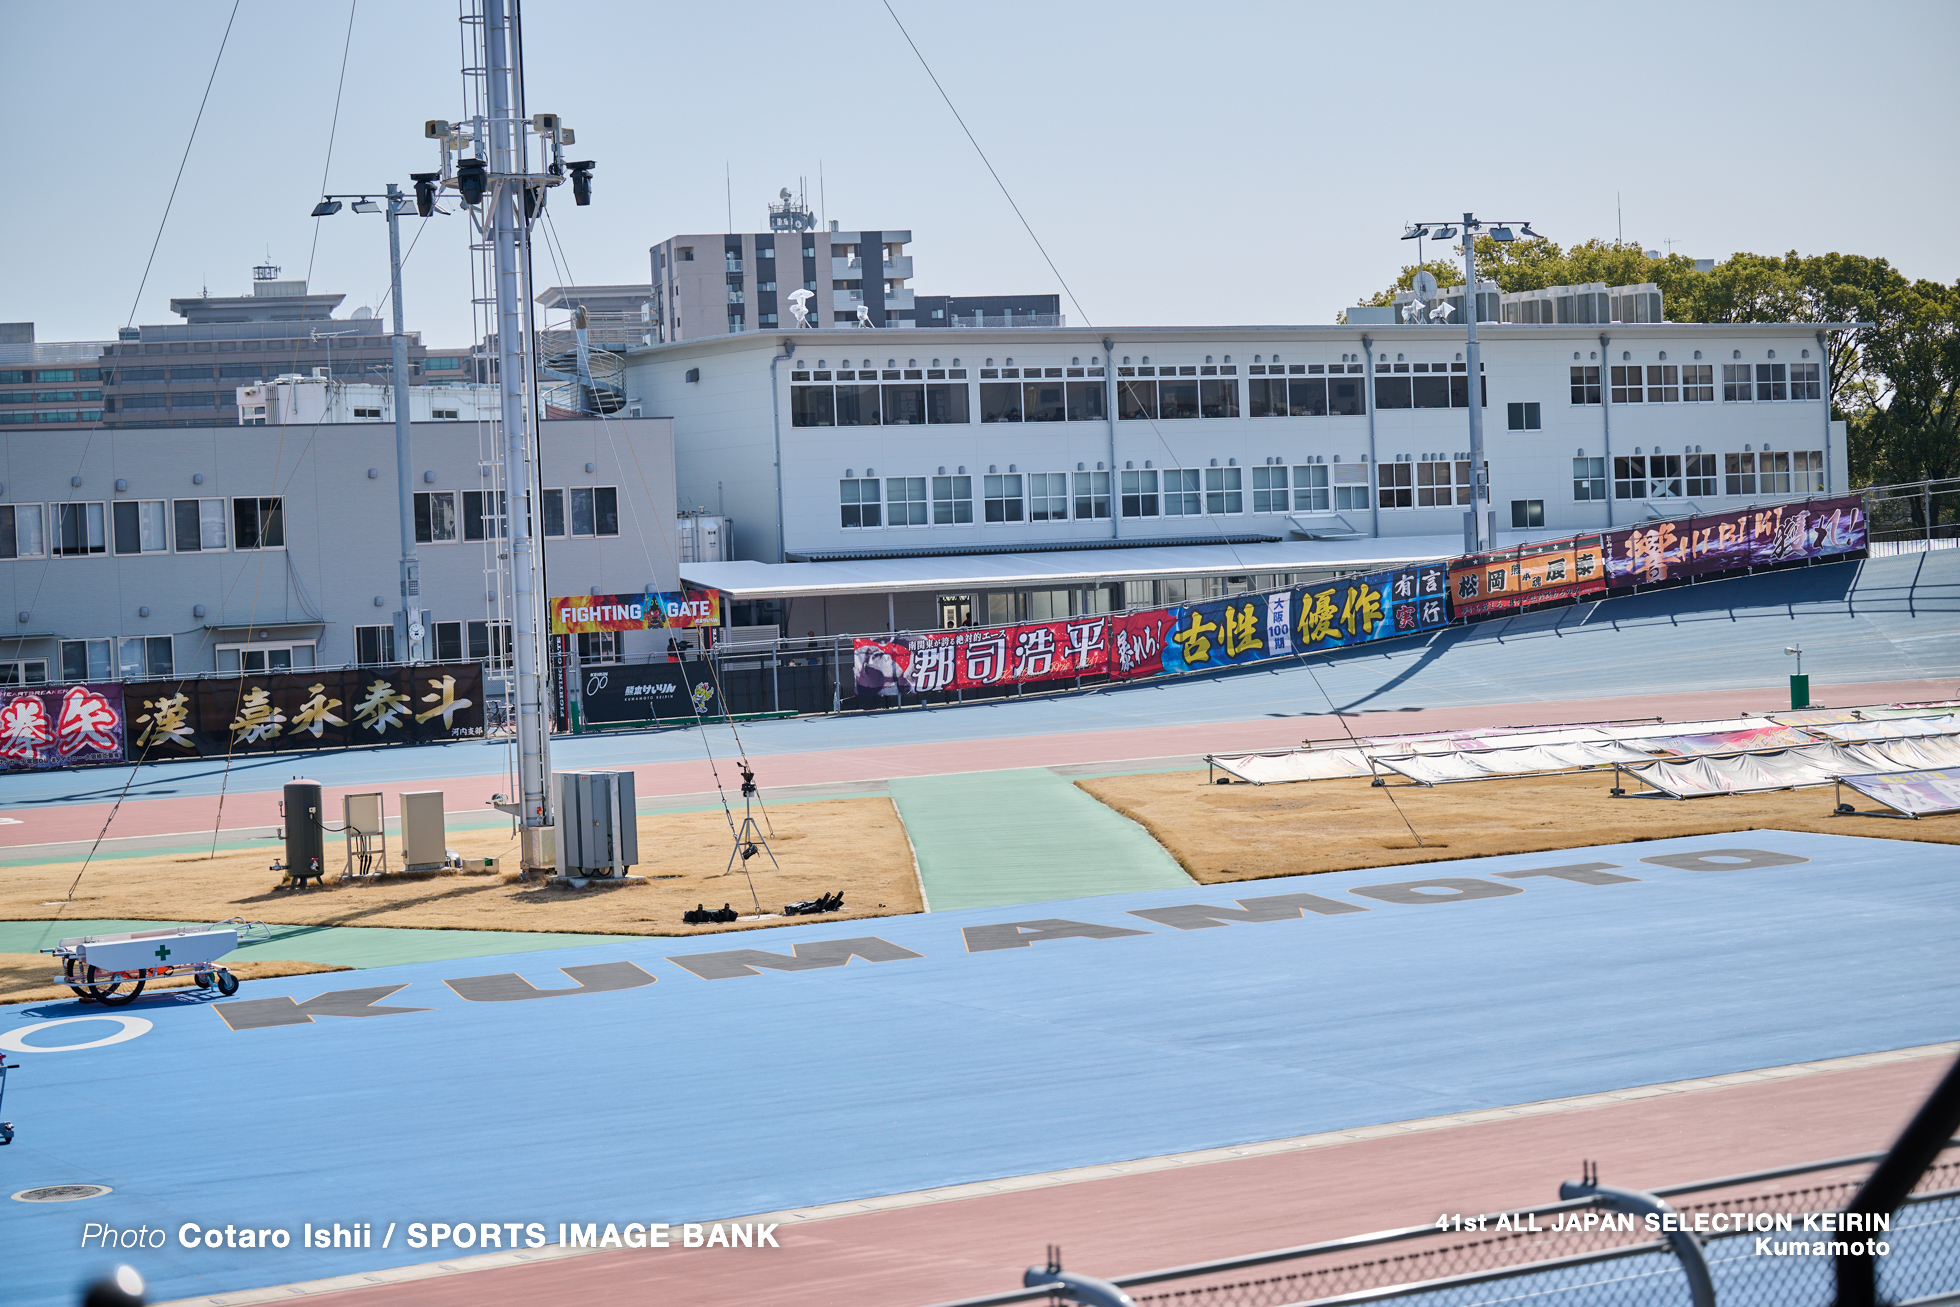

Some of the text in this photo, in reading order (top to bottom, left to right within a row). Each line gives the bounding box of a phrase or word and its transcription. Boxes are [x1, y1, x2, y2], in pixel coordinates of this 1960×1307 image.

[561, 600, 710, 623] FIGHTING GATE
[1297, 583, 1384, 645] 優作
[1458, 568, 1507, 599] 松岡
[914, 618, 1105, 691] 郡司浩平
[1173, 603, 1263, 664] 古性
[136, 692, 195, 748] 漢
[229, 674, 473, 745] 嘉永泰斗
[216, 847, 1809, 1031] KUMAMOTO
